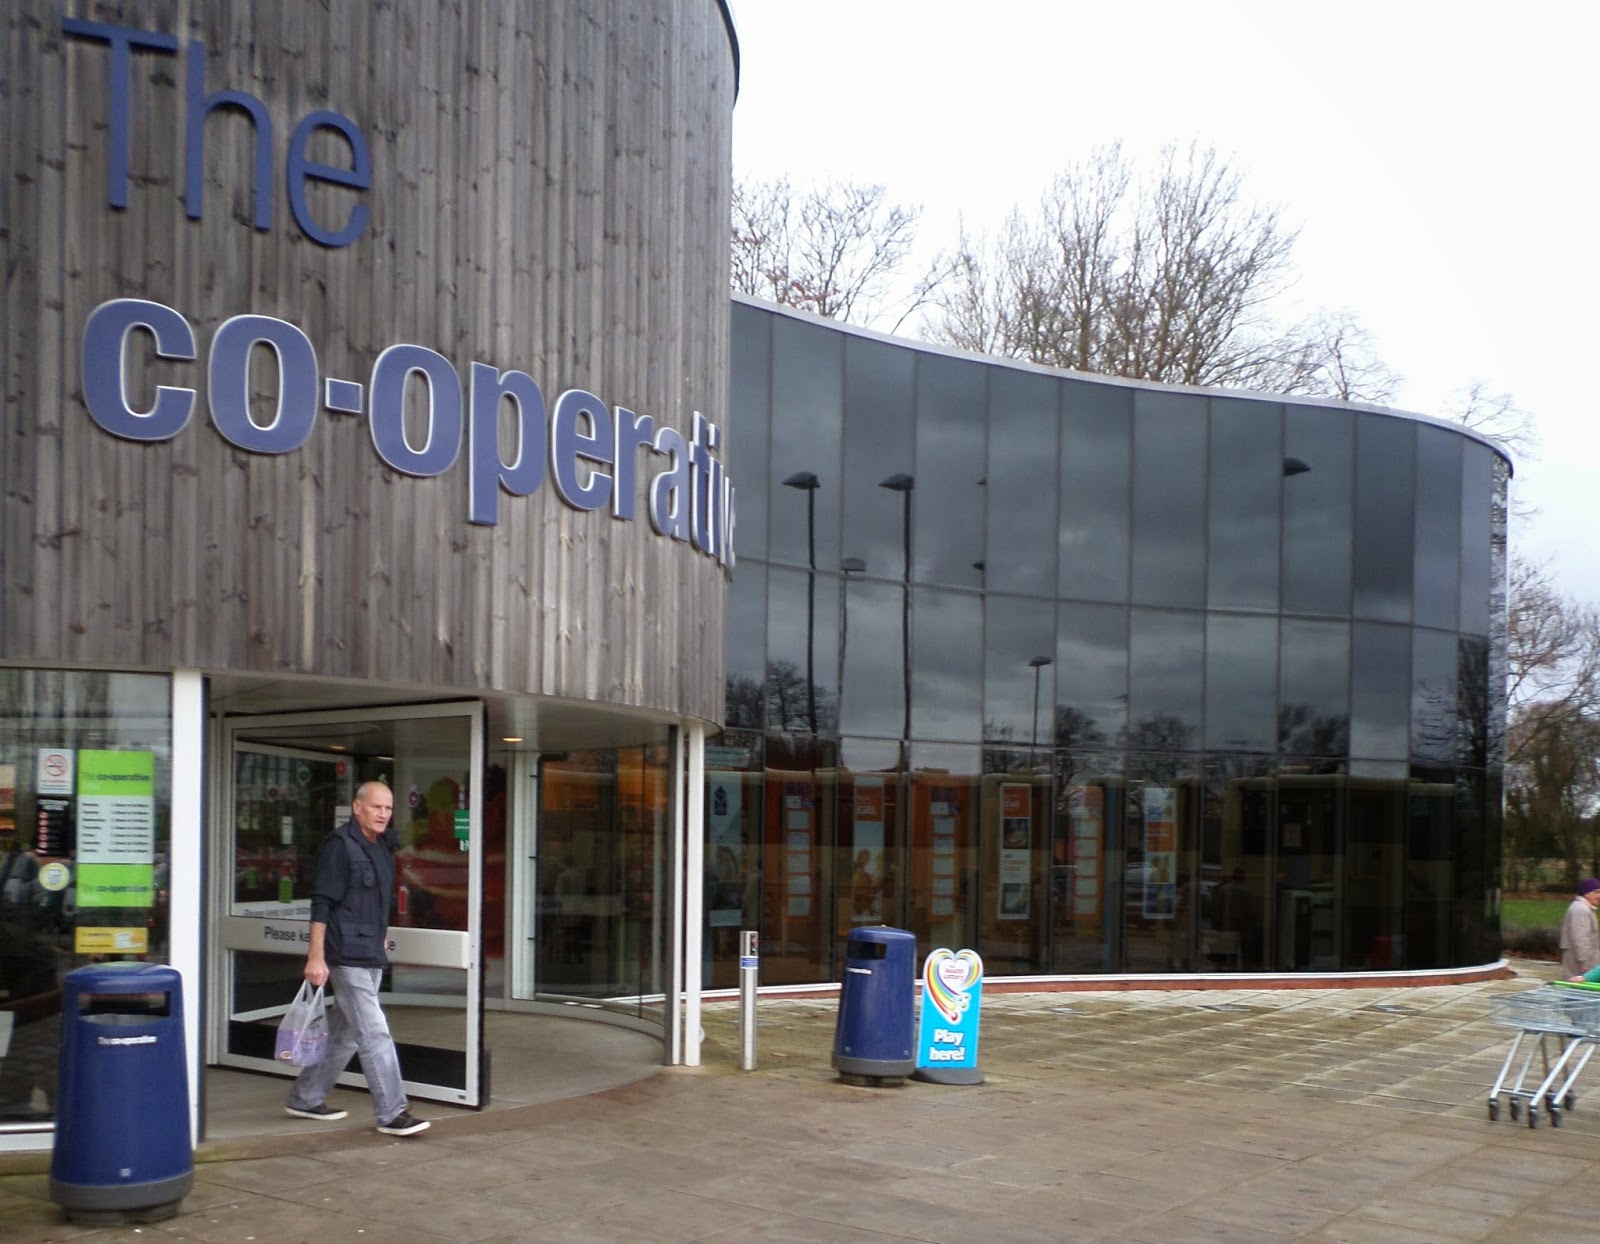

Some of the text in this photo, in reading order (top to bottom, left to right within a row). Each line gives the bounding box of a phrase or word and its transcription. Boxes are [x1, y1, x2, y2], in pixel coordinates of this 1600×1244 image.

[62, 17, 373, 249] The
[82, 297, 736, 569] co-operativ
[263, 925, 297, 942] Please
[933, 1029, 964, 1046] Play
[929, 1047, 965, 1061] here!
